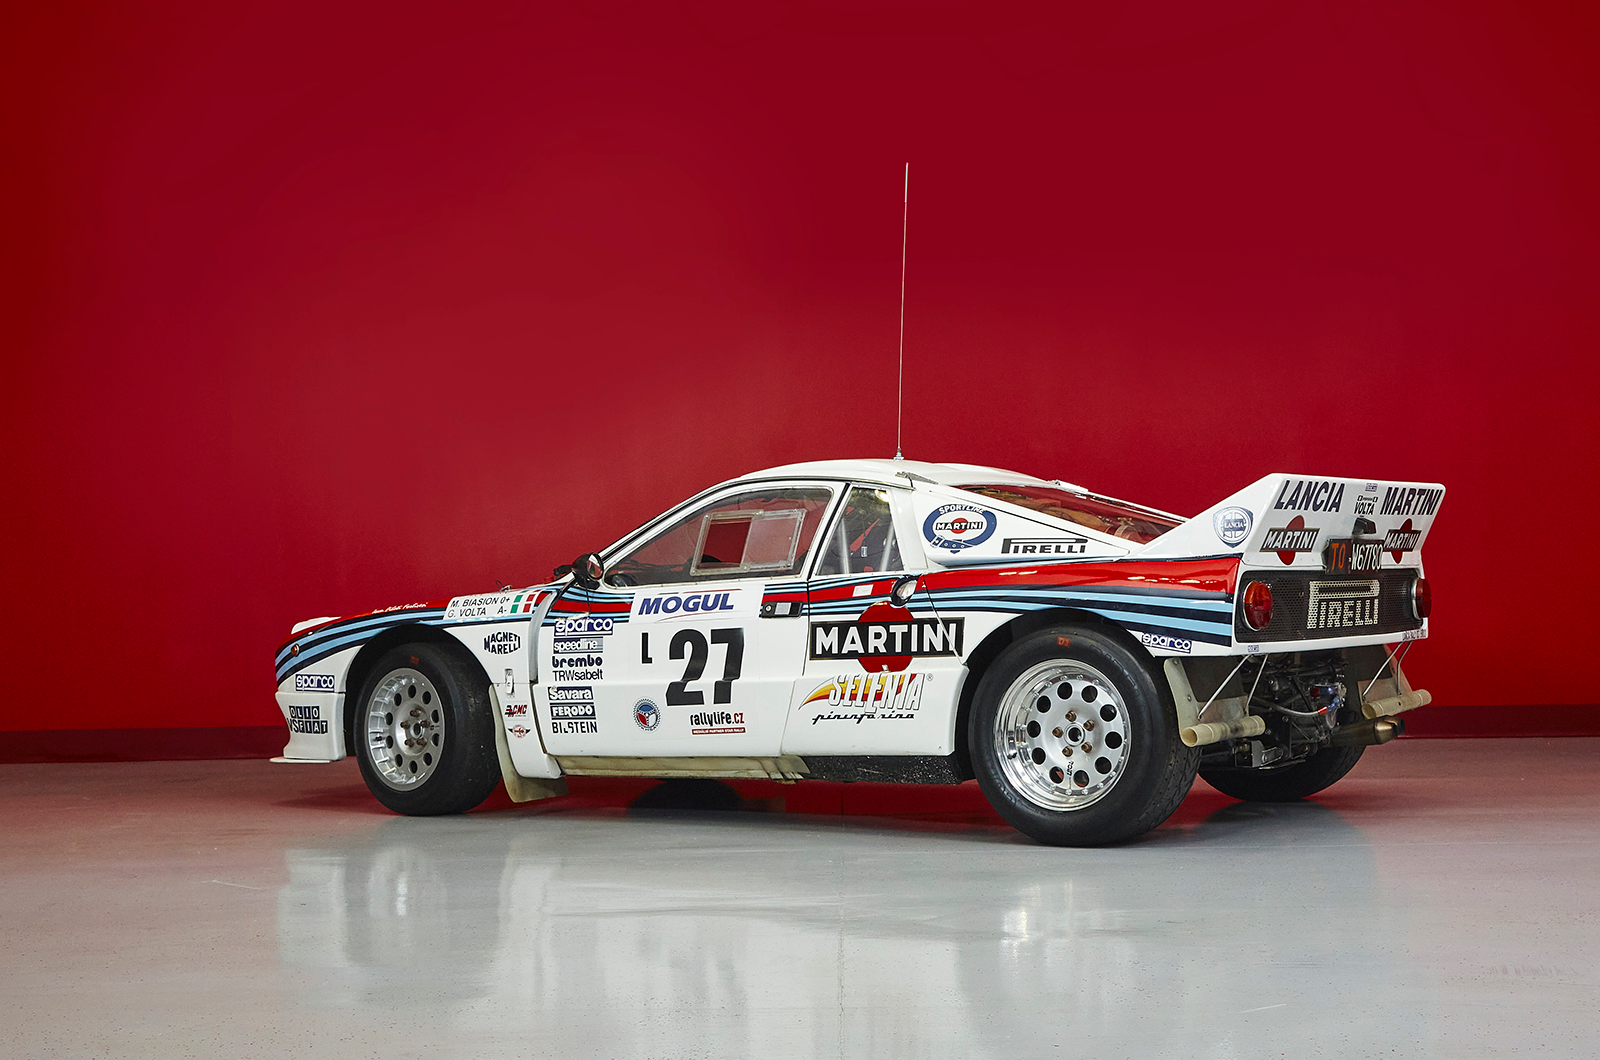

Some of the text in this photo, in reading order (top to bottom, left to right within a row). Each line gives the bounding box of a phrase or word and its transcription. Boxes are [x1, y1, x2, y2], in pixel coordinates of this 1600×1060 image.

[1274, 480, 1345, 512] LANCIA
[1380, 487, 1443, 515] MARTINI
[938, 504, 984, 515] SPORTLINE
[1354, 502, 1375, 515] VOLTA
[936, 522, 983, 530] MARTINI
[1001, 538, 1088, 554] PIRELLI
[1263, 531, 1317, 549] MARTINI
[1384, 532, 1420, 549] MARTINI
[1332, 543, 1346, 570] TO
[450, 600, 460, 608] M.
[462, 597, 498, 607] BIASION
[638, 593, 734, 616] MOGUL
[1307, 579, 1380, 629] PIRELLI
[448, 606, 507, 618] G. VOLTA A-
[555, 618, 613, 636] sparco
[484, 632, 521, 645] MAGNETI
[554, 638, 598, 652] speedline
[815, 623, 957, 655] MARTINI
[1142, 633, 1191, 652] sparco
[484, 641, 521, 654] MARELLI
[641, 632, 653, 664] L
[552, 655, 603, 668] brembo
[666, 628, 744, 706] 27
[296, 675, 335, 691] sparco
[549, 687, 592, 700] Savara
[828, 673, 925, 714] SELENIA
[289, 706, 319, 719] OLIO
[552, 705, 593, 718] FERODO
[690, 711, 745, 727] rallylife.cz
[552, 721, 598, 734] BILSTEIN
